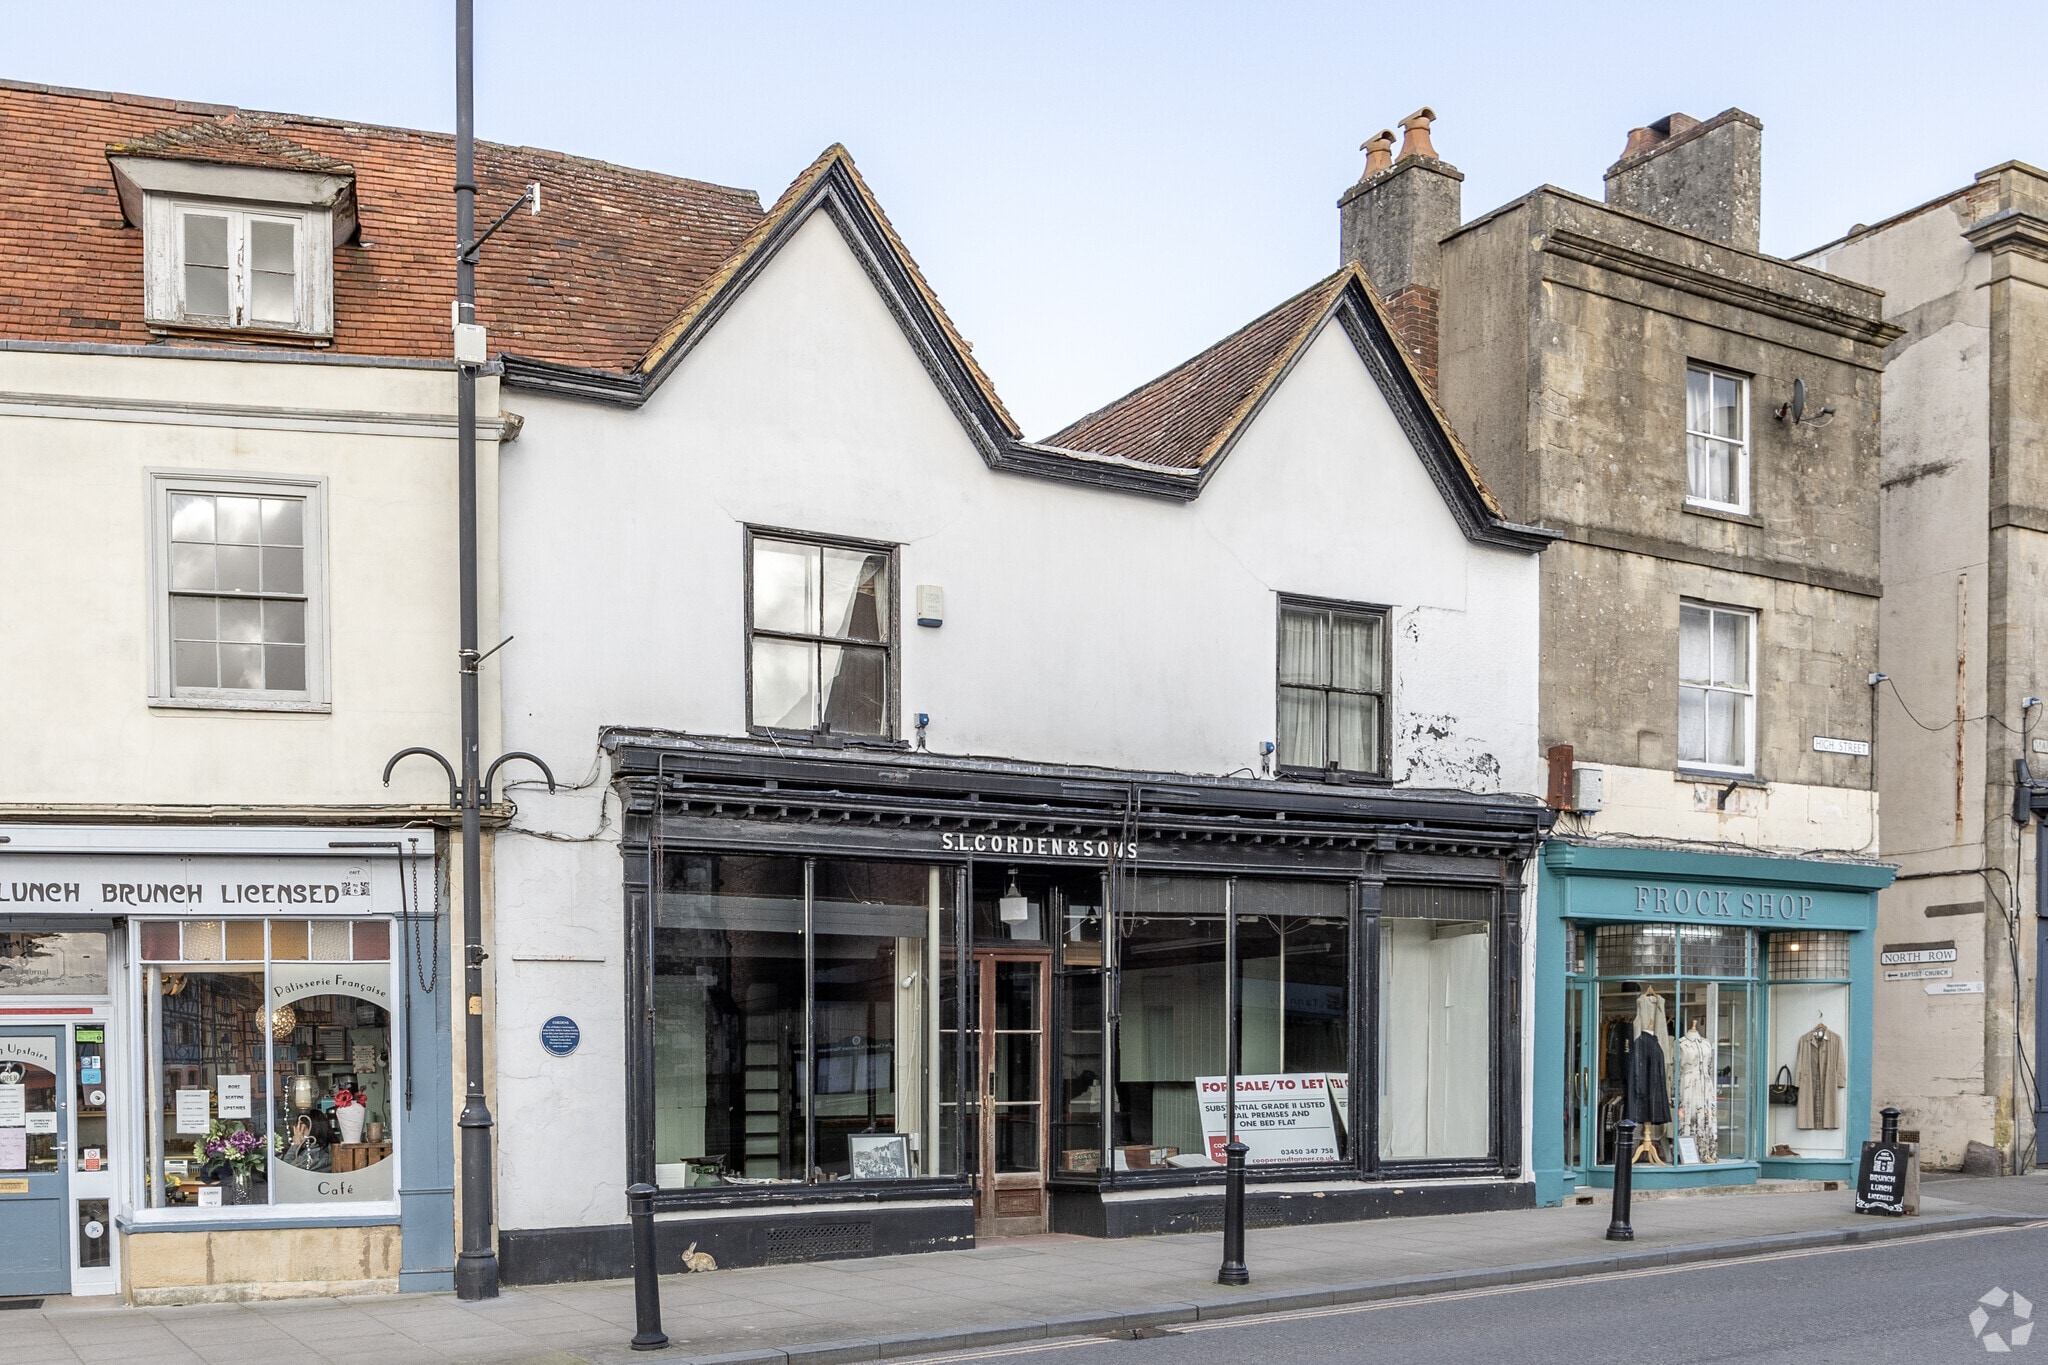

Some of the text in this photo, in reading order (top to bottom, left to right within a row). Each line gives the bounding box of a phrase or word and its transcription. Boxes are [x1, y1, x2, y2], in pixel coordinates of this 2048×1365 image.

[1815, 739, 1867, 753] HIGH STREET
[0, 882, 340, 906] LUNCH BRUNCH LICENSED
[1635, 886, 1813, 920] FROCK SHOP
[1884, 950, 1953, 963] NORTH ROW
[273, 974, 386, 998] Pâtisserie Française
[7, 1043, 48, 1060] Upstairs
[1302, 1079, 1325, 1089] LET
[1205, 1103, 1259, 1112] SUBSNTIAL
[1261, 1102, 1290, 1110] GRADE
[1300, 1101, 1326, 1109] LISTED
[1251, 1110, 1289, 1118] PREMISES
[318, 1181, 353, 1195] Café
